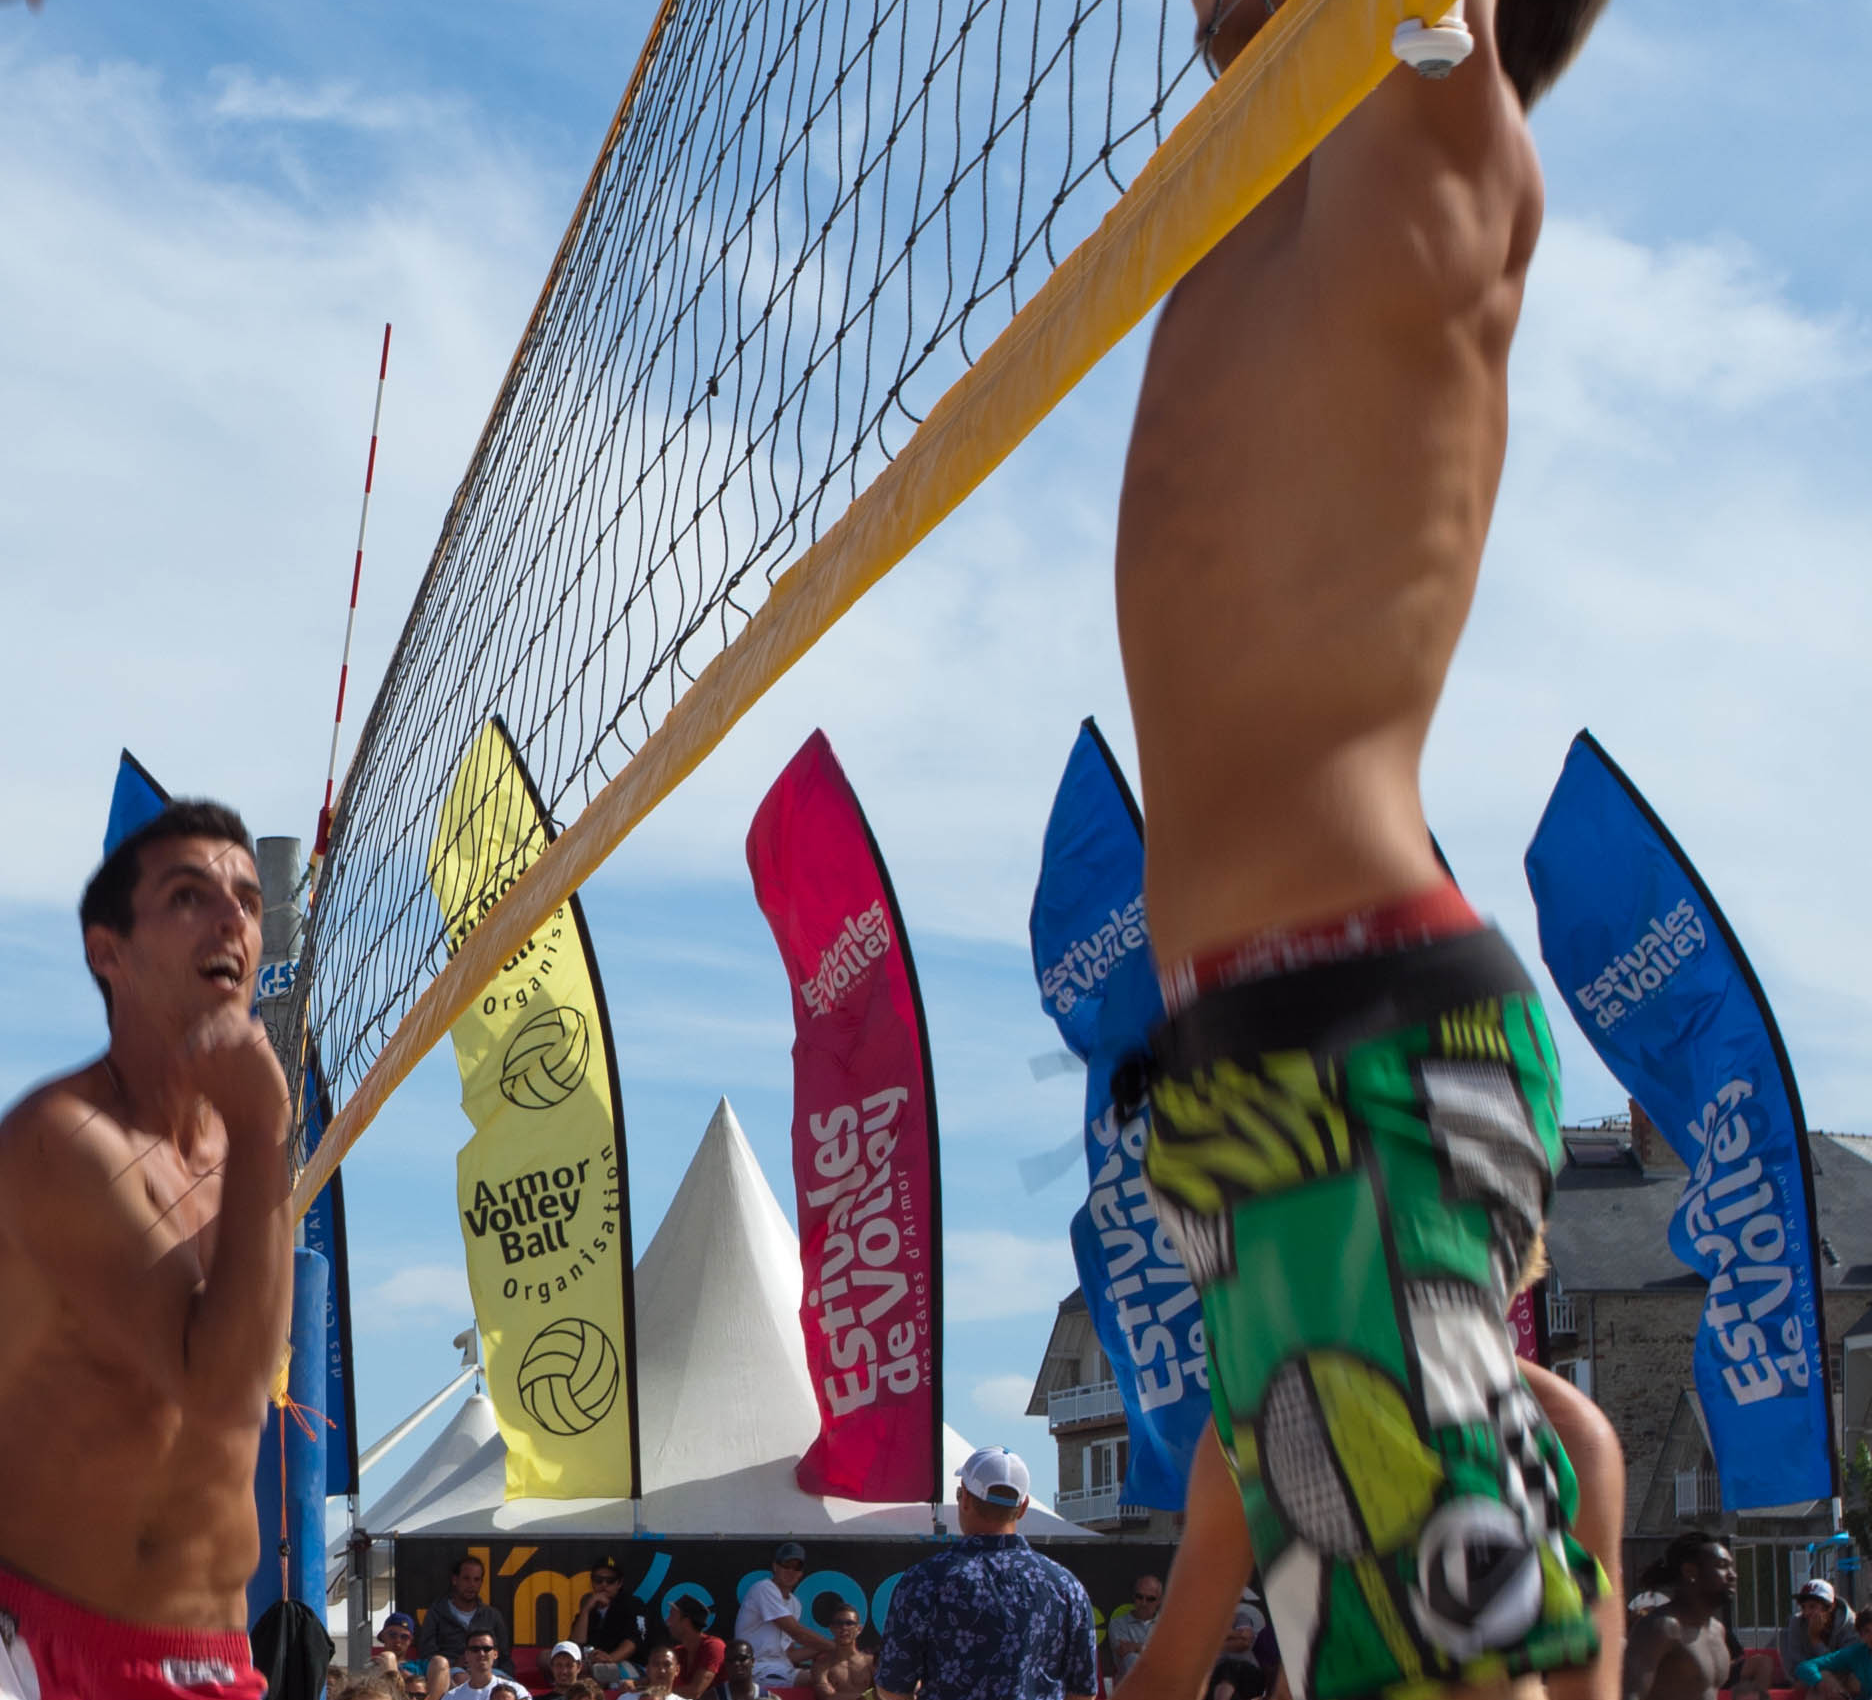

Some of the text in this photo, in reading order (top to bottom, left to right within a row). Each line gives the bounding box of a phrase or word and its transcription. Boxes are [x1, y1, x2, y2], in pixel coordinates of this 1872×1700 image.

[1576, 898, 1695, 1012] Estivales
[1595, 1000, 1626, 1029] de
[1614, 915, 1706, 1002] Volley
[464, 1188, 581, 1238] Volley
[474, 1158, 591, 1211] Armor
[503, 1145, 622, 1304] Organisation
[897, 1170, 921, 1259] d'Armor
[499, 1219, 570, 1265] Ball
[806, 1104, 879, 1417] Estivales
[878, 1321, 920, 1394] de
[1775, 1314, 1810, 1388] de
